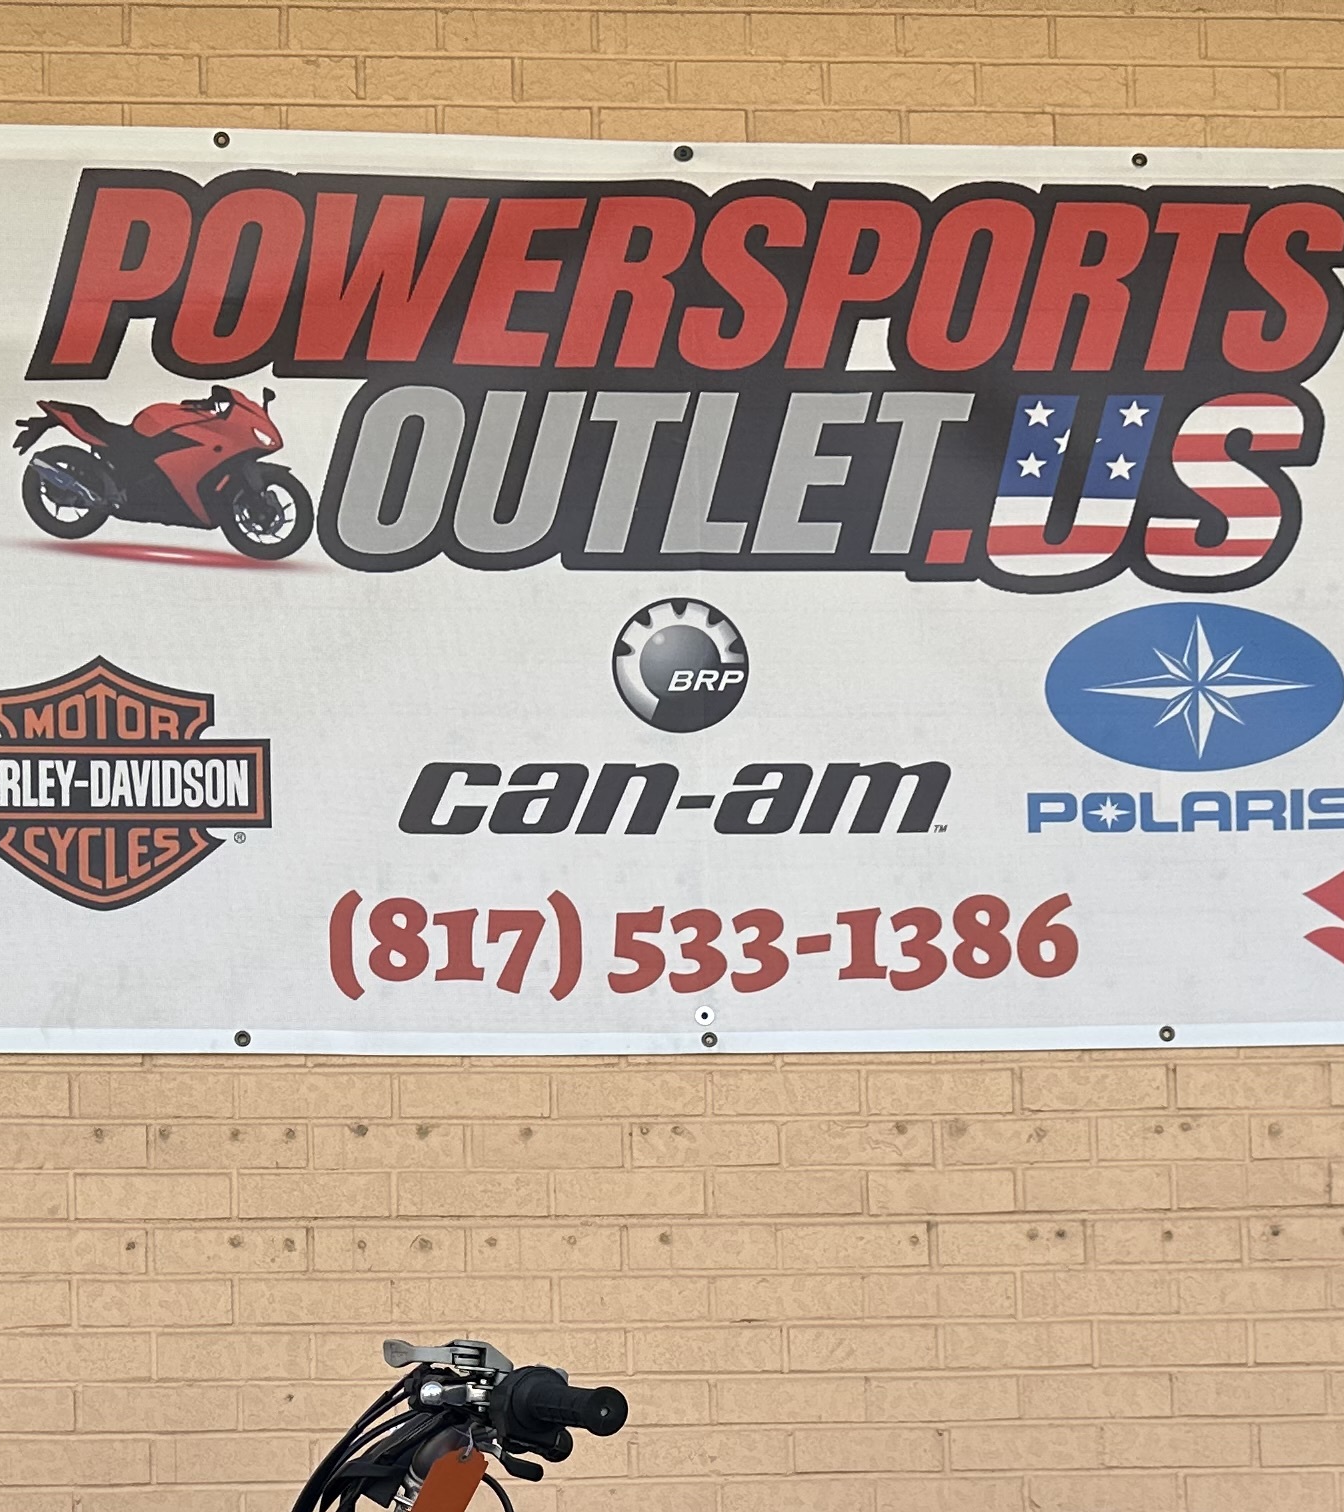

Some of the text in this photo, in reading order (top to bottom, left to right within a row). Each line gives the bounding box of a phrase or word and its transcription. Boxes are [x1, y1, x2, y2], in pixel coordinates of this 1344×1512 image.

[668, 668, 745, 692] BRP
[24, 682, 180, 740] MOTOR
[23, 826, 180, 890] CYCLES
[329, 889, 1080, 1001] (817) 533-1386
